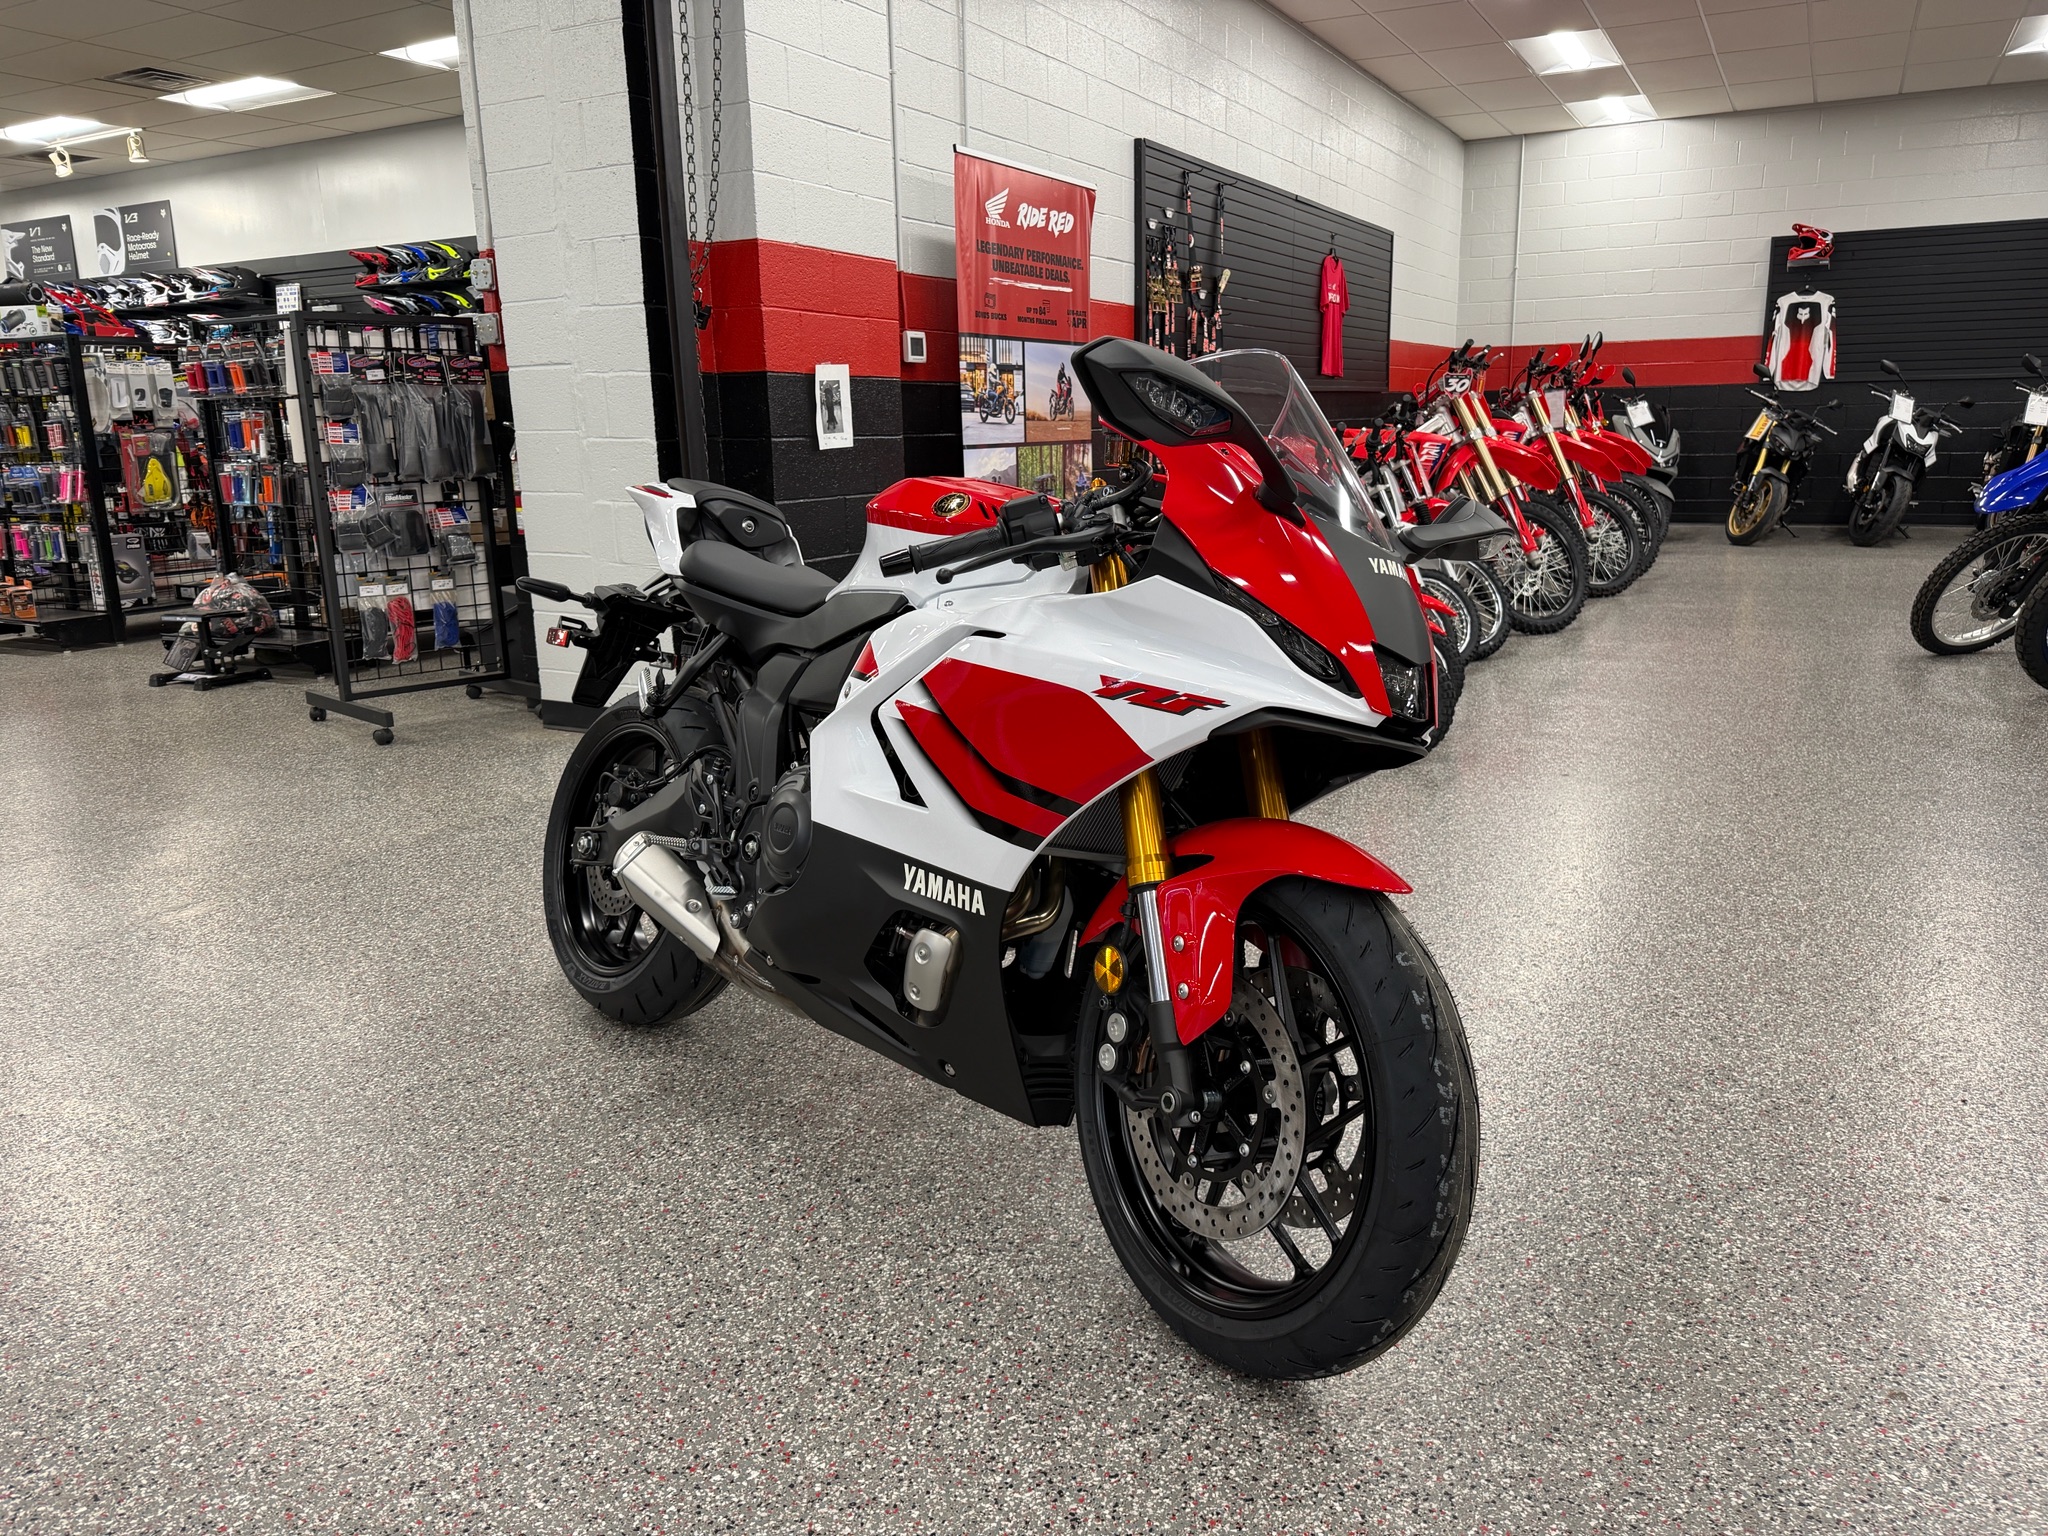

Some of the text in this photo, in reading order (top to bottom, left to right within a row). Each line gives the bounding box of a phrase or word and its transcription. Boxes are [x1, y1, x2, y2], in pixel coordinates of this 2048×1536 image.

[985, 216, 1011, 229] HONDA
[1016, 202, 1075, 239] RIDE RED
[126, 230, 160, 243] Race-Ready
[31, 244, 53, 254] The New
[127, 241, 157, 252] Motocross
[32, 252, 55, 263] Standard
[128, 250, 150, 261] Helmet
[976, 239, 1084, 271] LEGENDARY PERFORMANCE.
[992, 258, 1071, 283] UNBEATABLE DEALS.
[975, 310, 1007, 321] BONUS BUCKS
[1026, 306, 1047, 316] UP TO 84
[1017, 315, 1058, 327] MONTHS FINANCING
[1072, 317, 1087, 329] APR
[1445, 378, 1470, 393] 30
[1368, 557, 1409, 582] YAMA
[903, 862, 986, 917] YAMAHA
